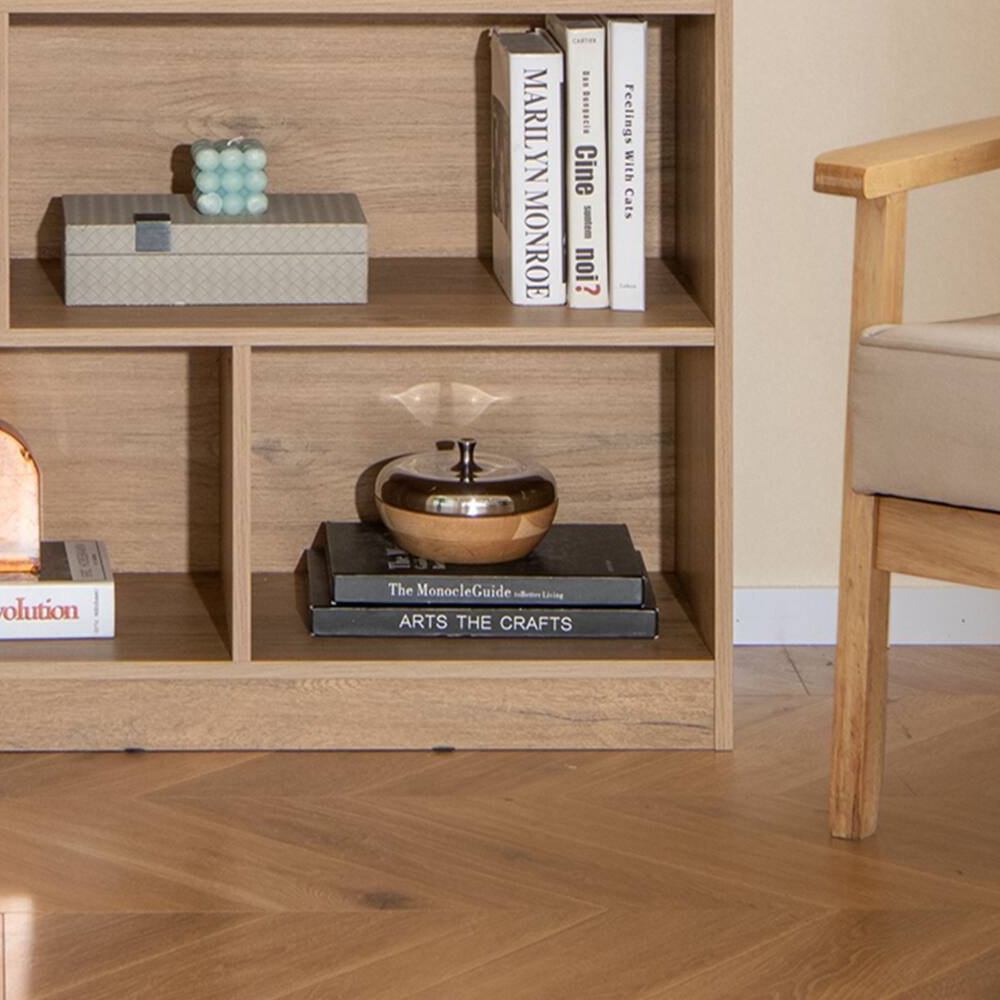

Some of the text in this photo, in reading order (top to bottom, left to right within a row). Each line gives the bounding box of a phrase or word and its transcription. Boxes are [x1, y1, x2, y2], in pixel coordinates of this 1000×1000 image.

[575, 145, 598, 196] Cine
[622, 84, 635, 219] Feelings With Cats
[523, 68, 551, 299] MARILYN MONROE
[575, 248, 601, 296] noi?
[388, 582, 413, 597] The
[399, 614, 573, 631] ARTS THE CRAFTS
